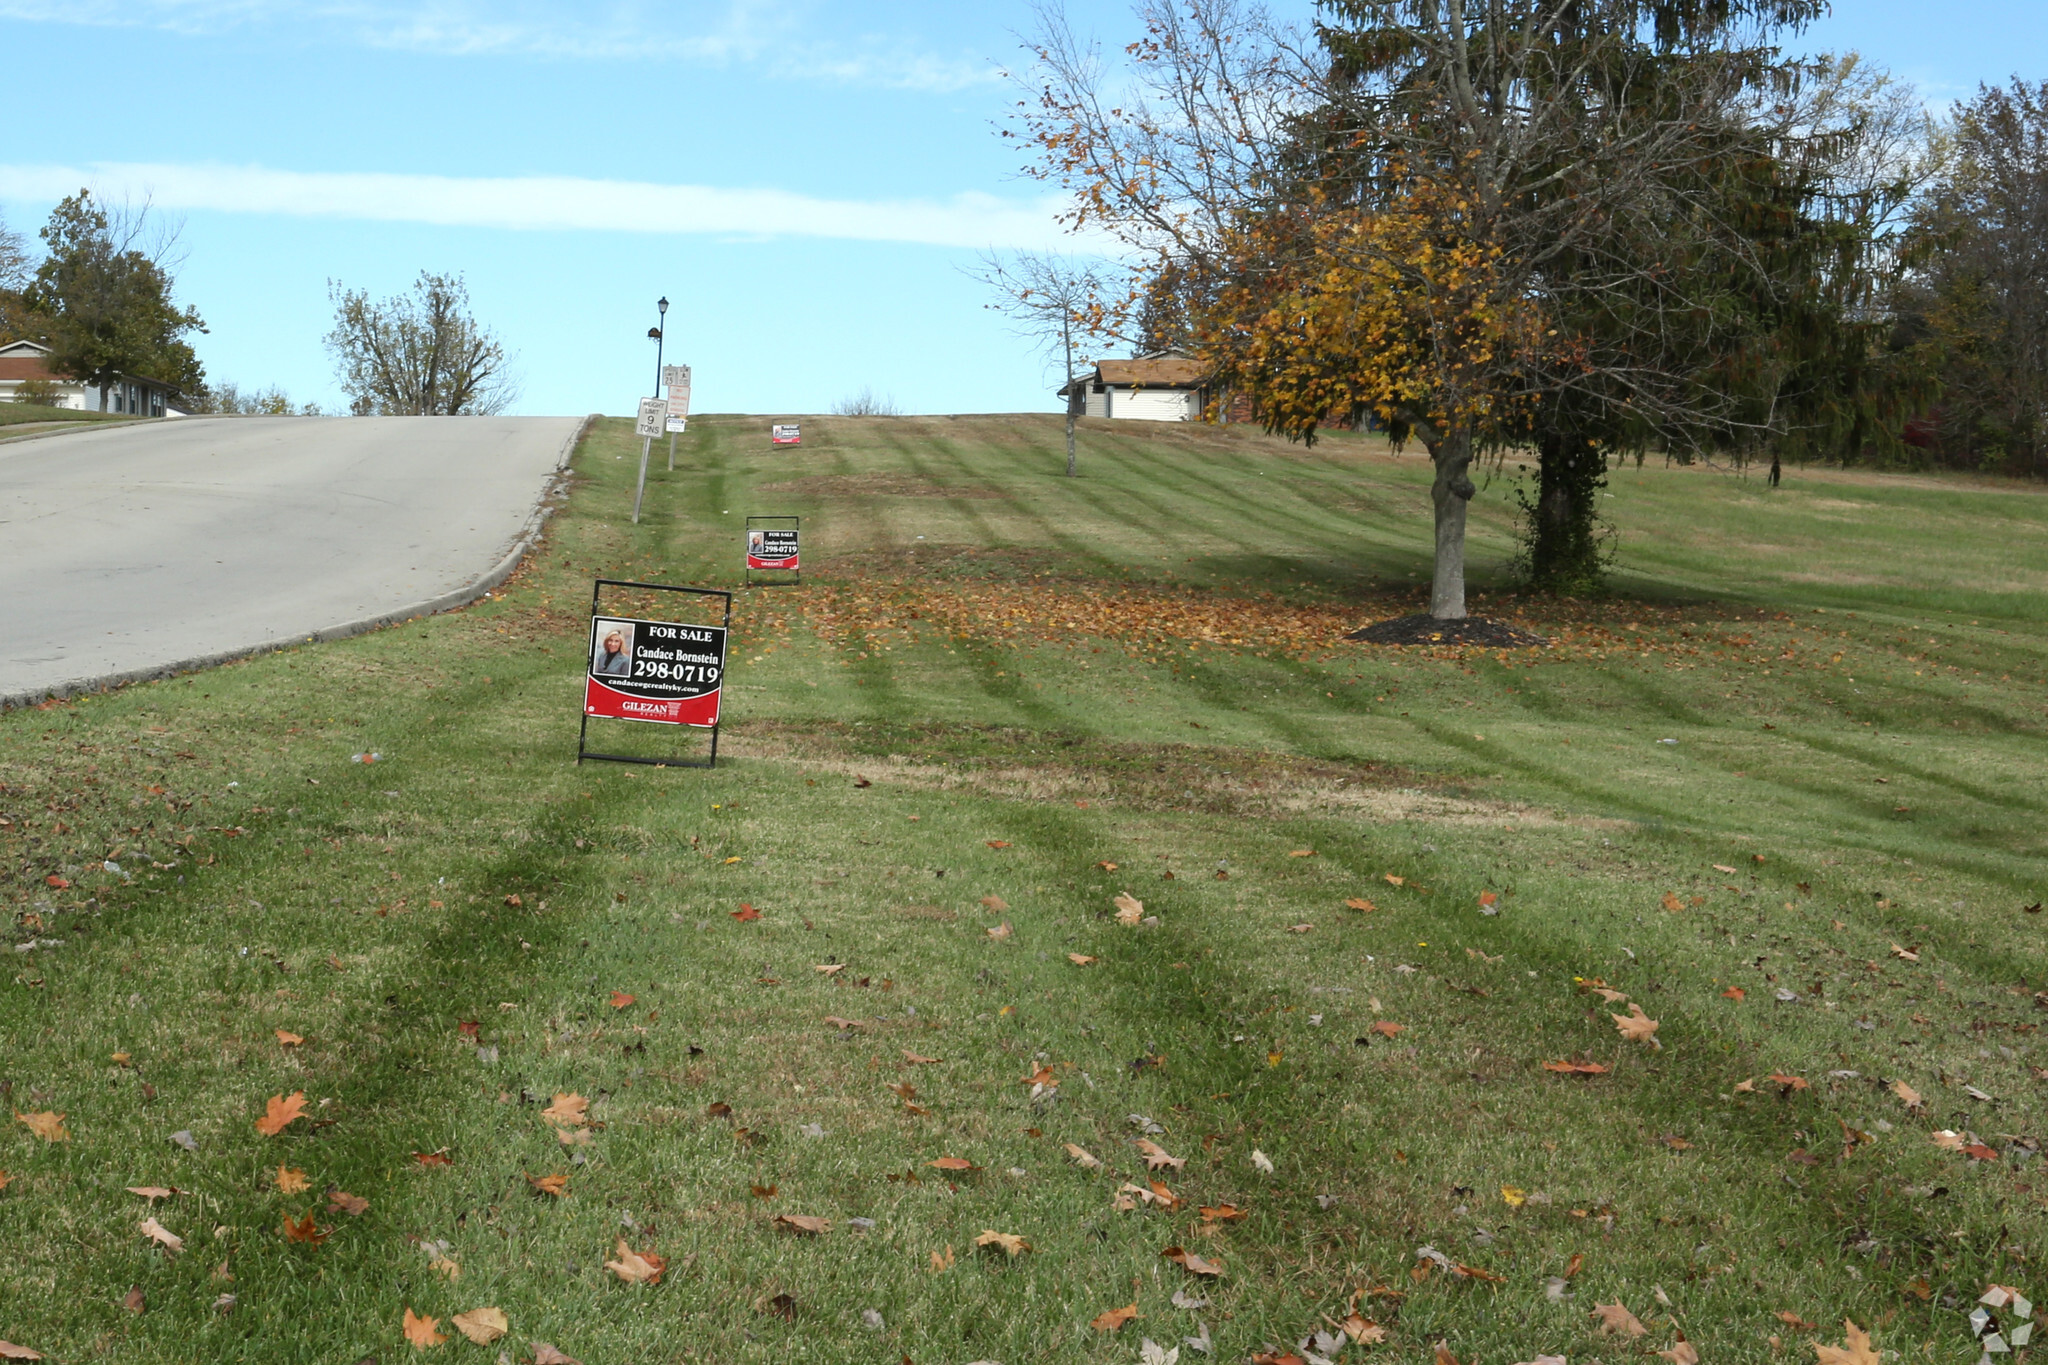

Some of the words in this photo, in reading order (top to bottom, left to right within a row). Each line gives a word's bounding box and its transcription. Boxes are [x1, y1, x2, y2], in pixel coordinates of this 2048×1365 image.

[643, 401, 665, 409] WEIGHT
[647, 415, 655, 425] 9
[640, 424, 660, 434] TONS
[764, 545, 798, 553] 298-0719
[649, 626, 677, 639] FOR
[679, 629, 713, 643] SALE
[636, 645, 674, 661] Candace
[675, 649, 719, 665] Bornstein
[633, 660, 719, 684] 298-0719
[622, 701, 668, 713] GILEZAN
